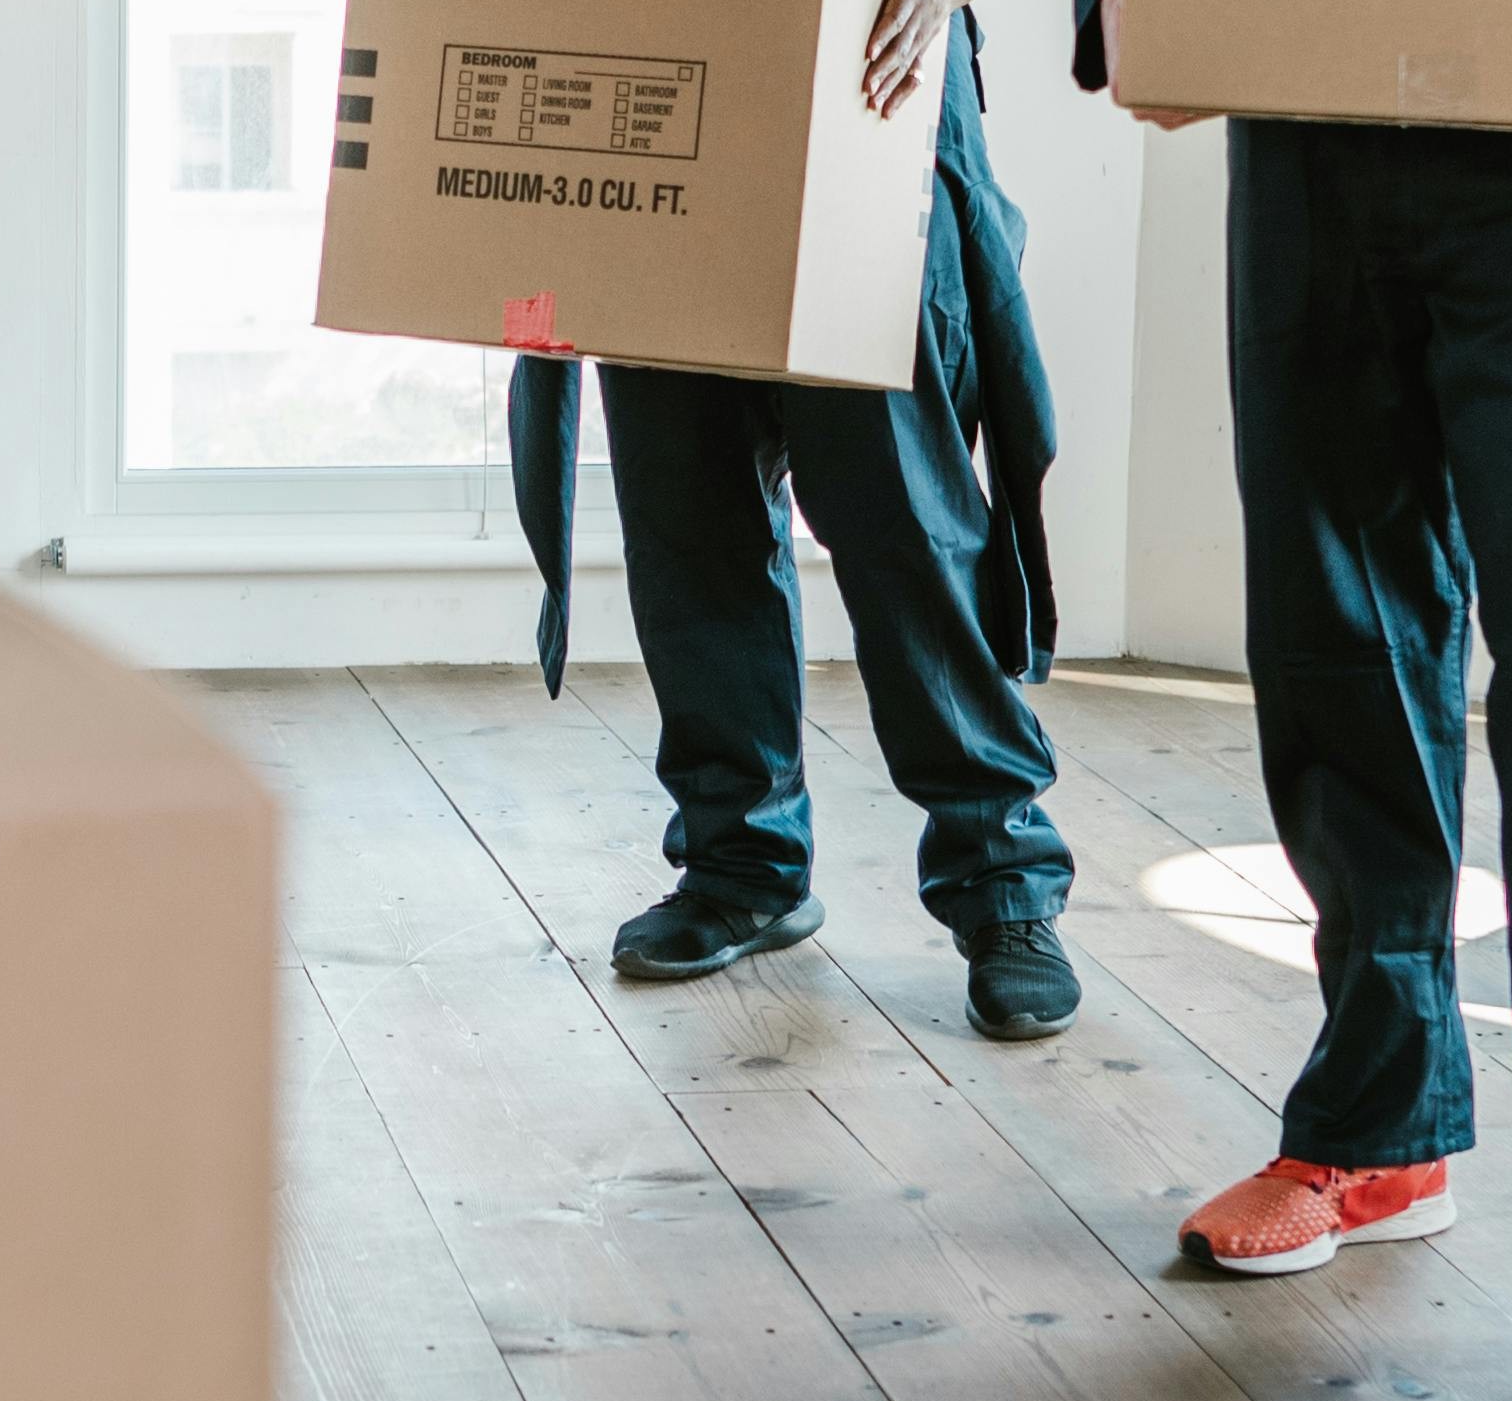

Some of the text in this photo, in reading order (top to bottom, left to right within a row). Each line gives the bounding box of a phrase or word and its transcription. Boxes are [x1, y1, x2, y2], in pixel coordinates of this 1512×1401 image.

[461, 51, 537, 69] BEDROOM
[477, 73, 508, 87] MASTER
[542, 78, 592, 92] LIVING ROOM
[476, 90, 501, 103] GUEST
[635, 84, 677, 99] BATHROOM
[567, 98, 592, 110] ROOM
[633, 102, 674, 116] BASEMENT
[474, 107, 497, 121] GIRLS
[538, 113, 571, 126] KITCHEN
[472, 125, 493, 138] BOYS
[631, 119, 663, 133] GARAGE
[629, 137, 651, 150] ATTIC
[436, 166, 687, 216] MEDIUM-3.0 CU. FT.
